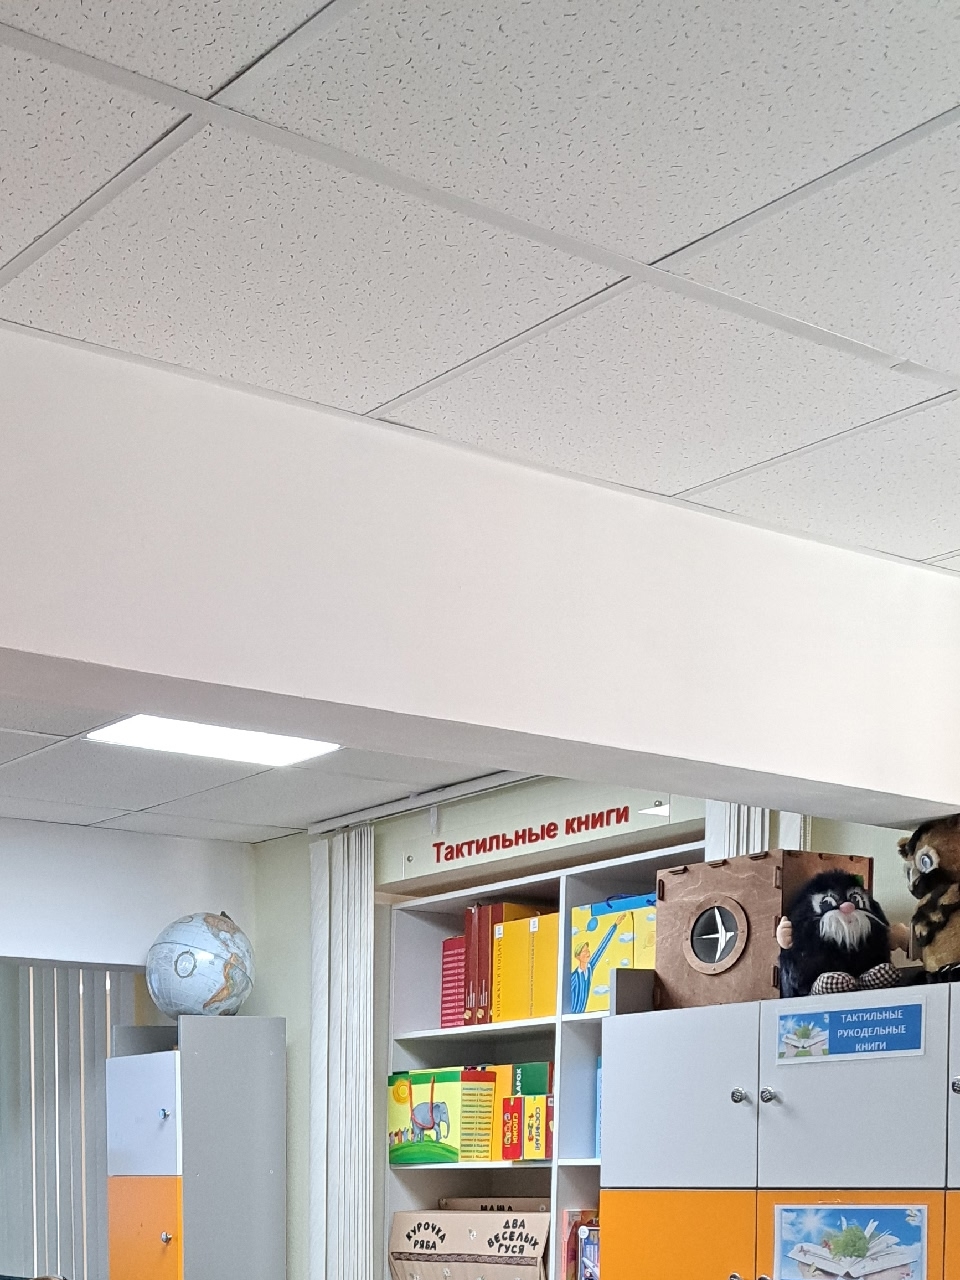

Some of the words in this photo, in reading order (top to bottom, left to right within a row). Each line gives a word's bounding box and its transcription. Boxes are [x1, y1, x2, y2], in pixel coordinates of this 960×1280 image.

[432, 822, 559, 864] Тактильные
[565, 805, 630, 836] книги
[841, 1010, 904, 1024] ТАКТИЛЬНЫЕ
[837, 1025, 907, 1039] РУКОДЕЛЬНЫЕ
[855, 1041, 887, 1052] КНИГИ
[502, 1219, 526, 1230] ДВА
[405, 1221, 447, 1243] КУРОЧКА
[413, 1239, 437, 1251] РЯБА
[487, 1231, 540, 1250] ВЕСЕЛЫХ
[497, 1242, 525, 1255] ГУСЯ
